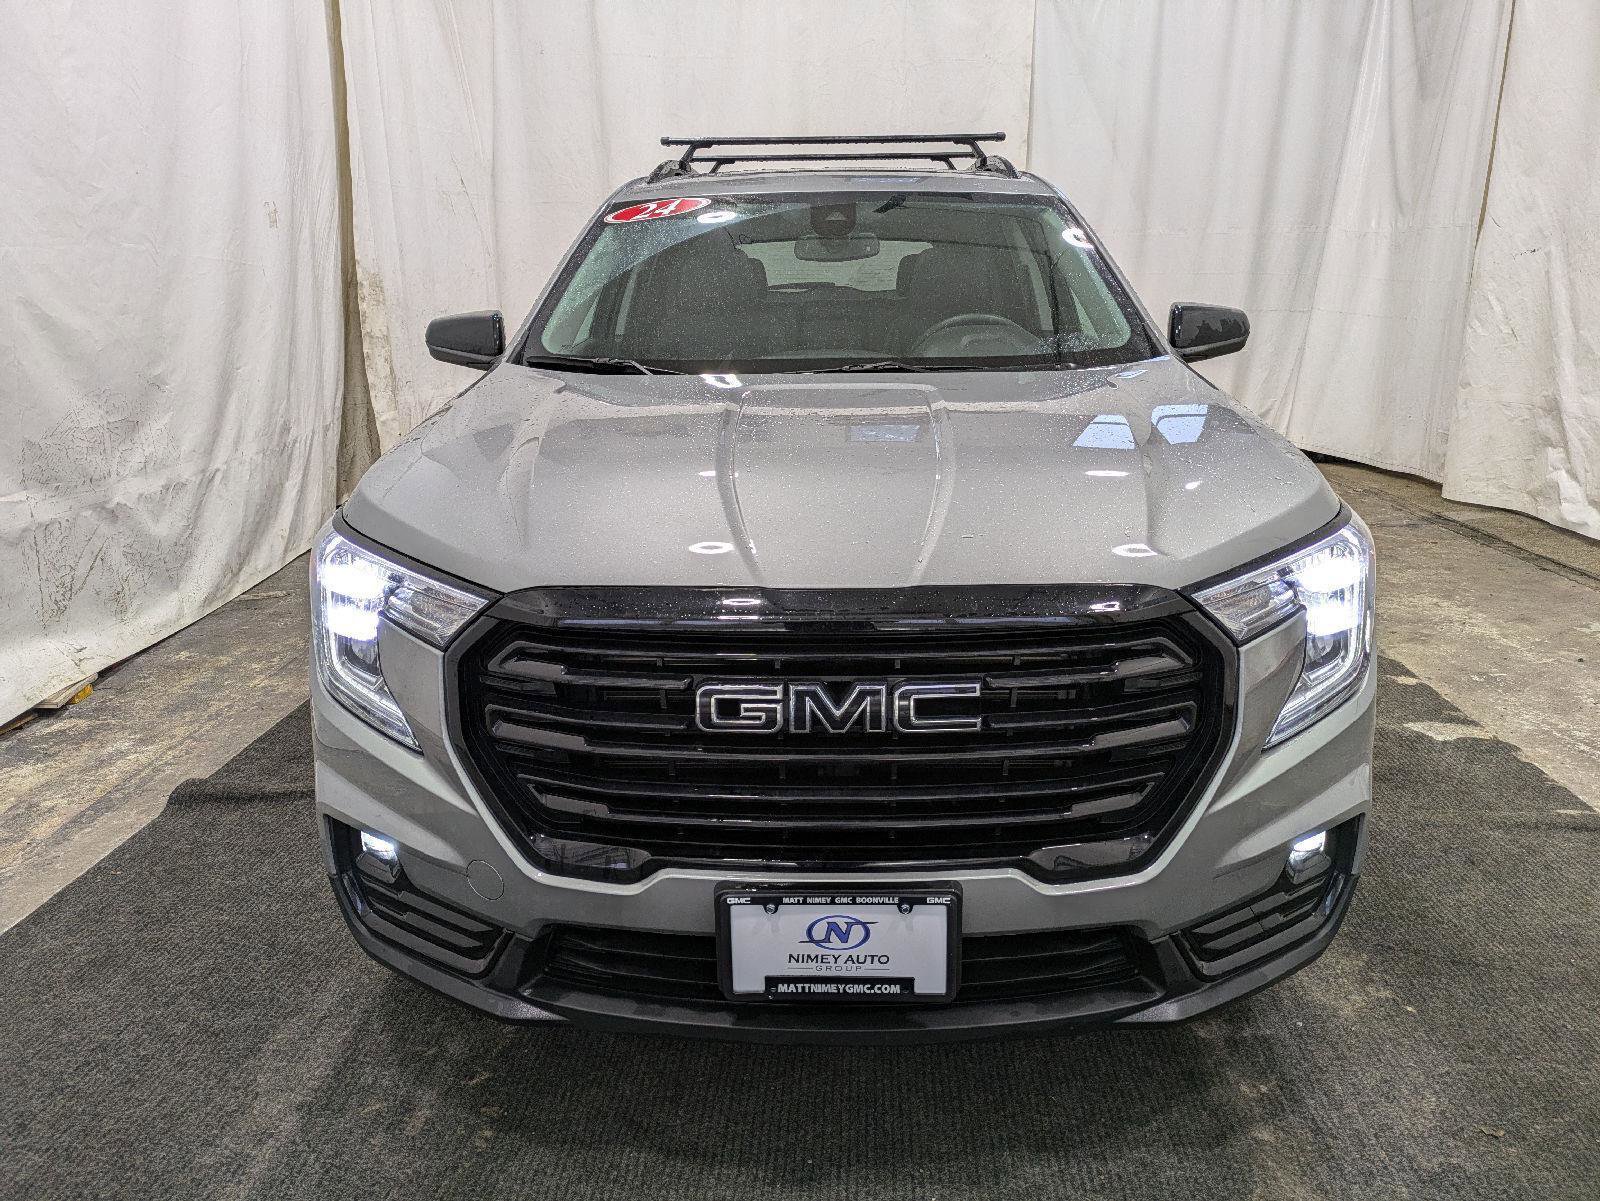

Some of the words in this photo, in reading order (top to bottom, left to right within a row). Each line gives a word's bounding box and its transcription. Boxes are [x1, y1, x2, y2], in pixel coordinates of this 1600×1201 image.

[629, 199, 681, 221] 24
[695, 682, 981, 733] GMC
[788, 953, 842, 964] NIMEY
[844, 954, 890, 965] AUTO
[777, 983, 901, 994] MATTNIMEYGMC.COM
